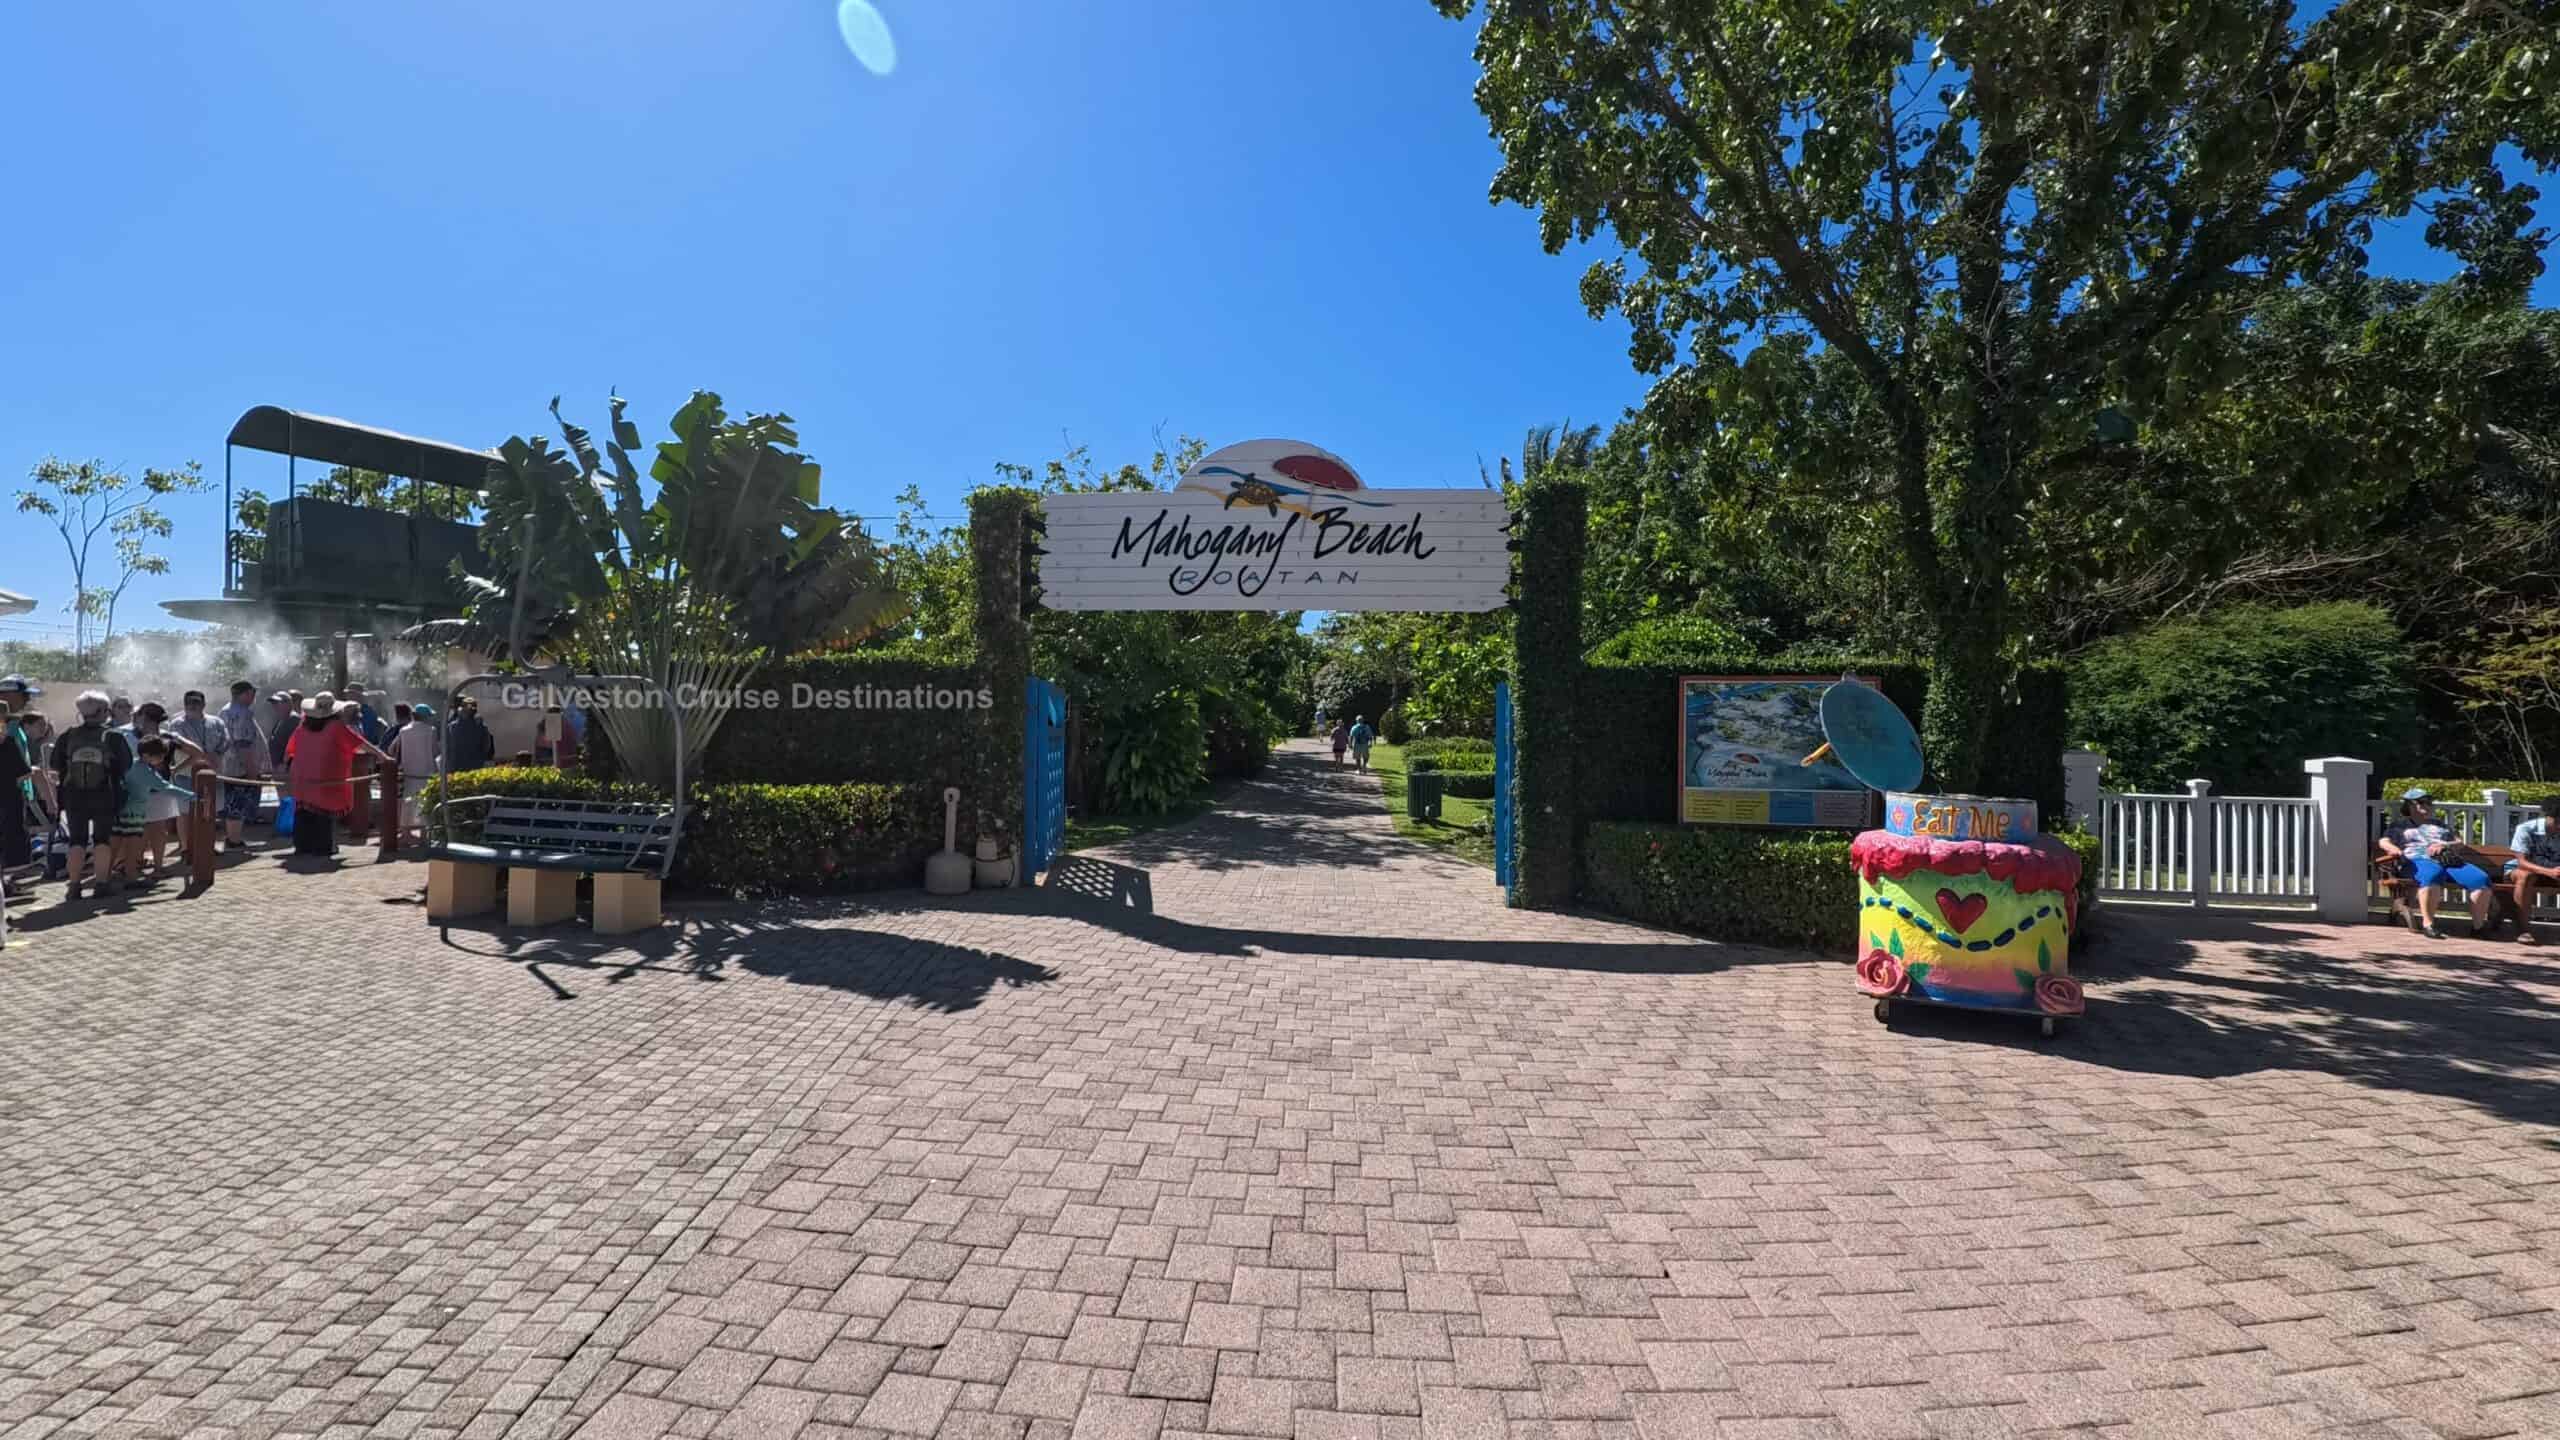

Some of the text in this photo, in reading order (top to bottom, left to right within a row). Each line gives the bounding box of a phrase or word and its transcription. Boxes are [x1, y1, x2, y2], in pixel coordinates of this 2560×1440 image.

[1111, 506, 1436, 597] Mahogany Beach
[1178, 570, 1358, 585] ROATAN
[1912, 799, 2010, 840] Eat Me
